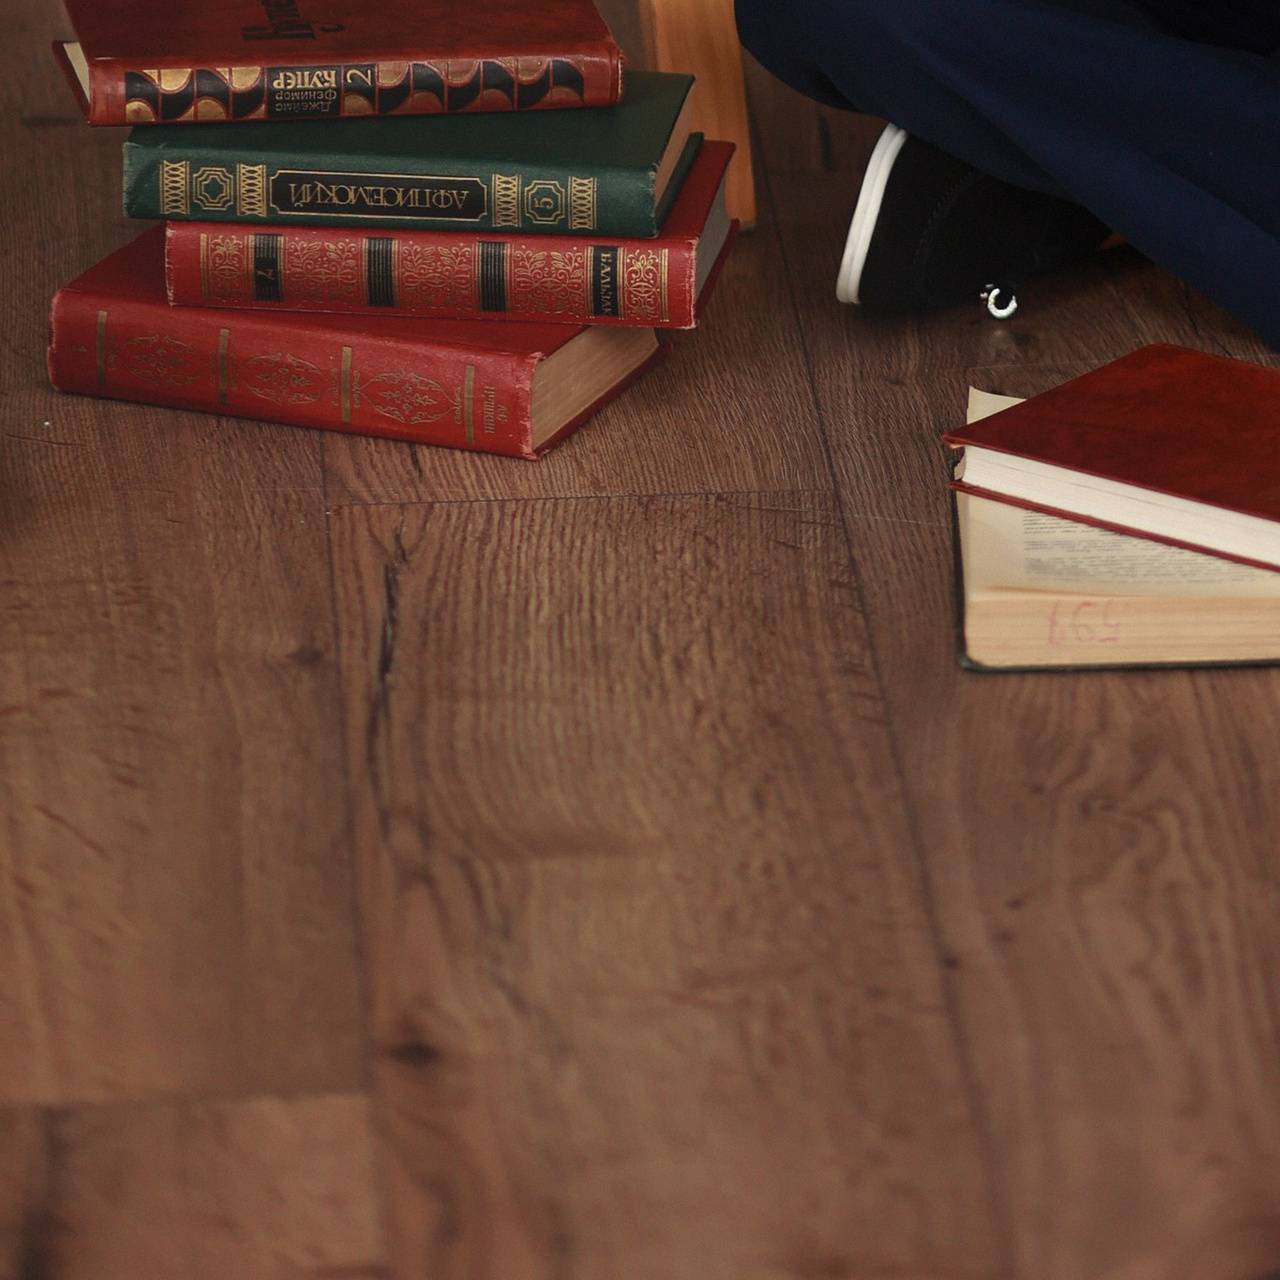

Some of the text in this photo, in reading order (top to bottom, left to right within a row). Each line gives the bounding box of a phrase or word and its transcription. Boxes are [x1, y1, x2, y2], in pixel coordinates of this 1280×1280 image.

[272, 69, 337, 90] КУПЕР
[345, 68, 372, 87] 2
[275, 88, 338, 101] Фенимор
[533, 196, 555, 210] 5
